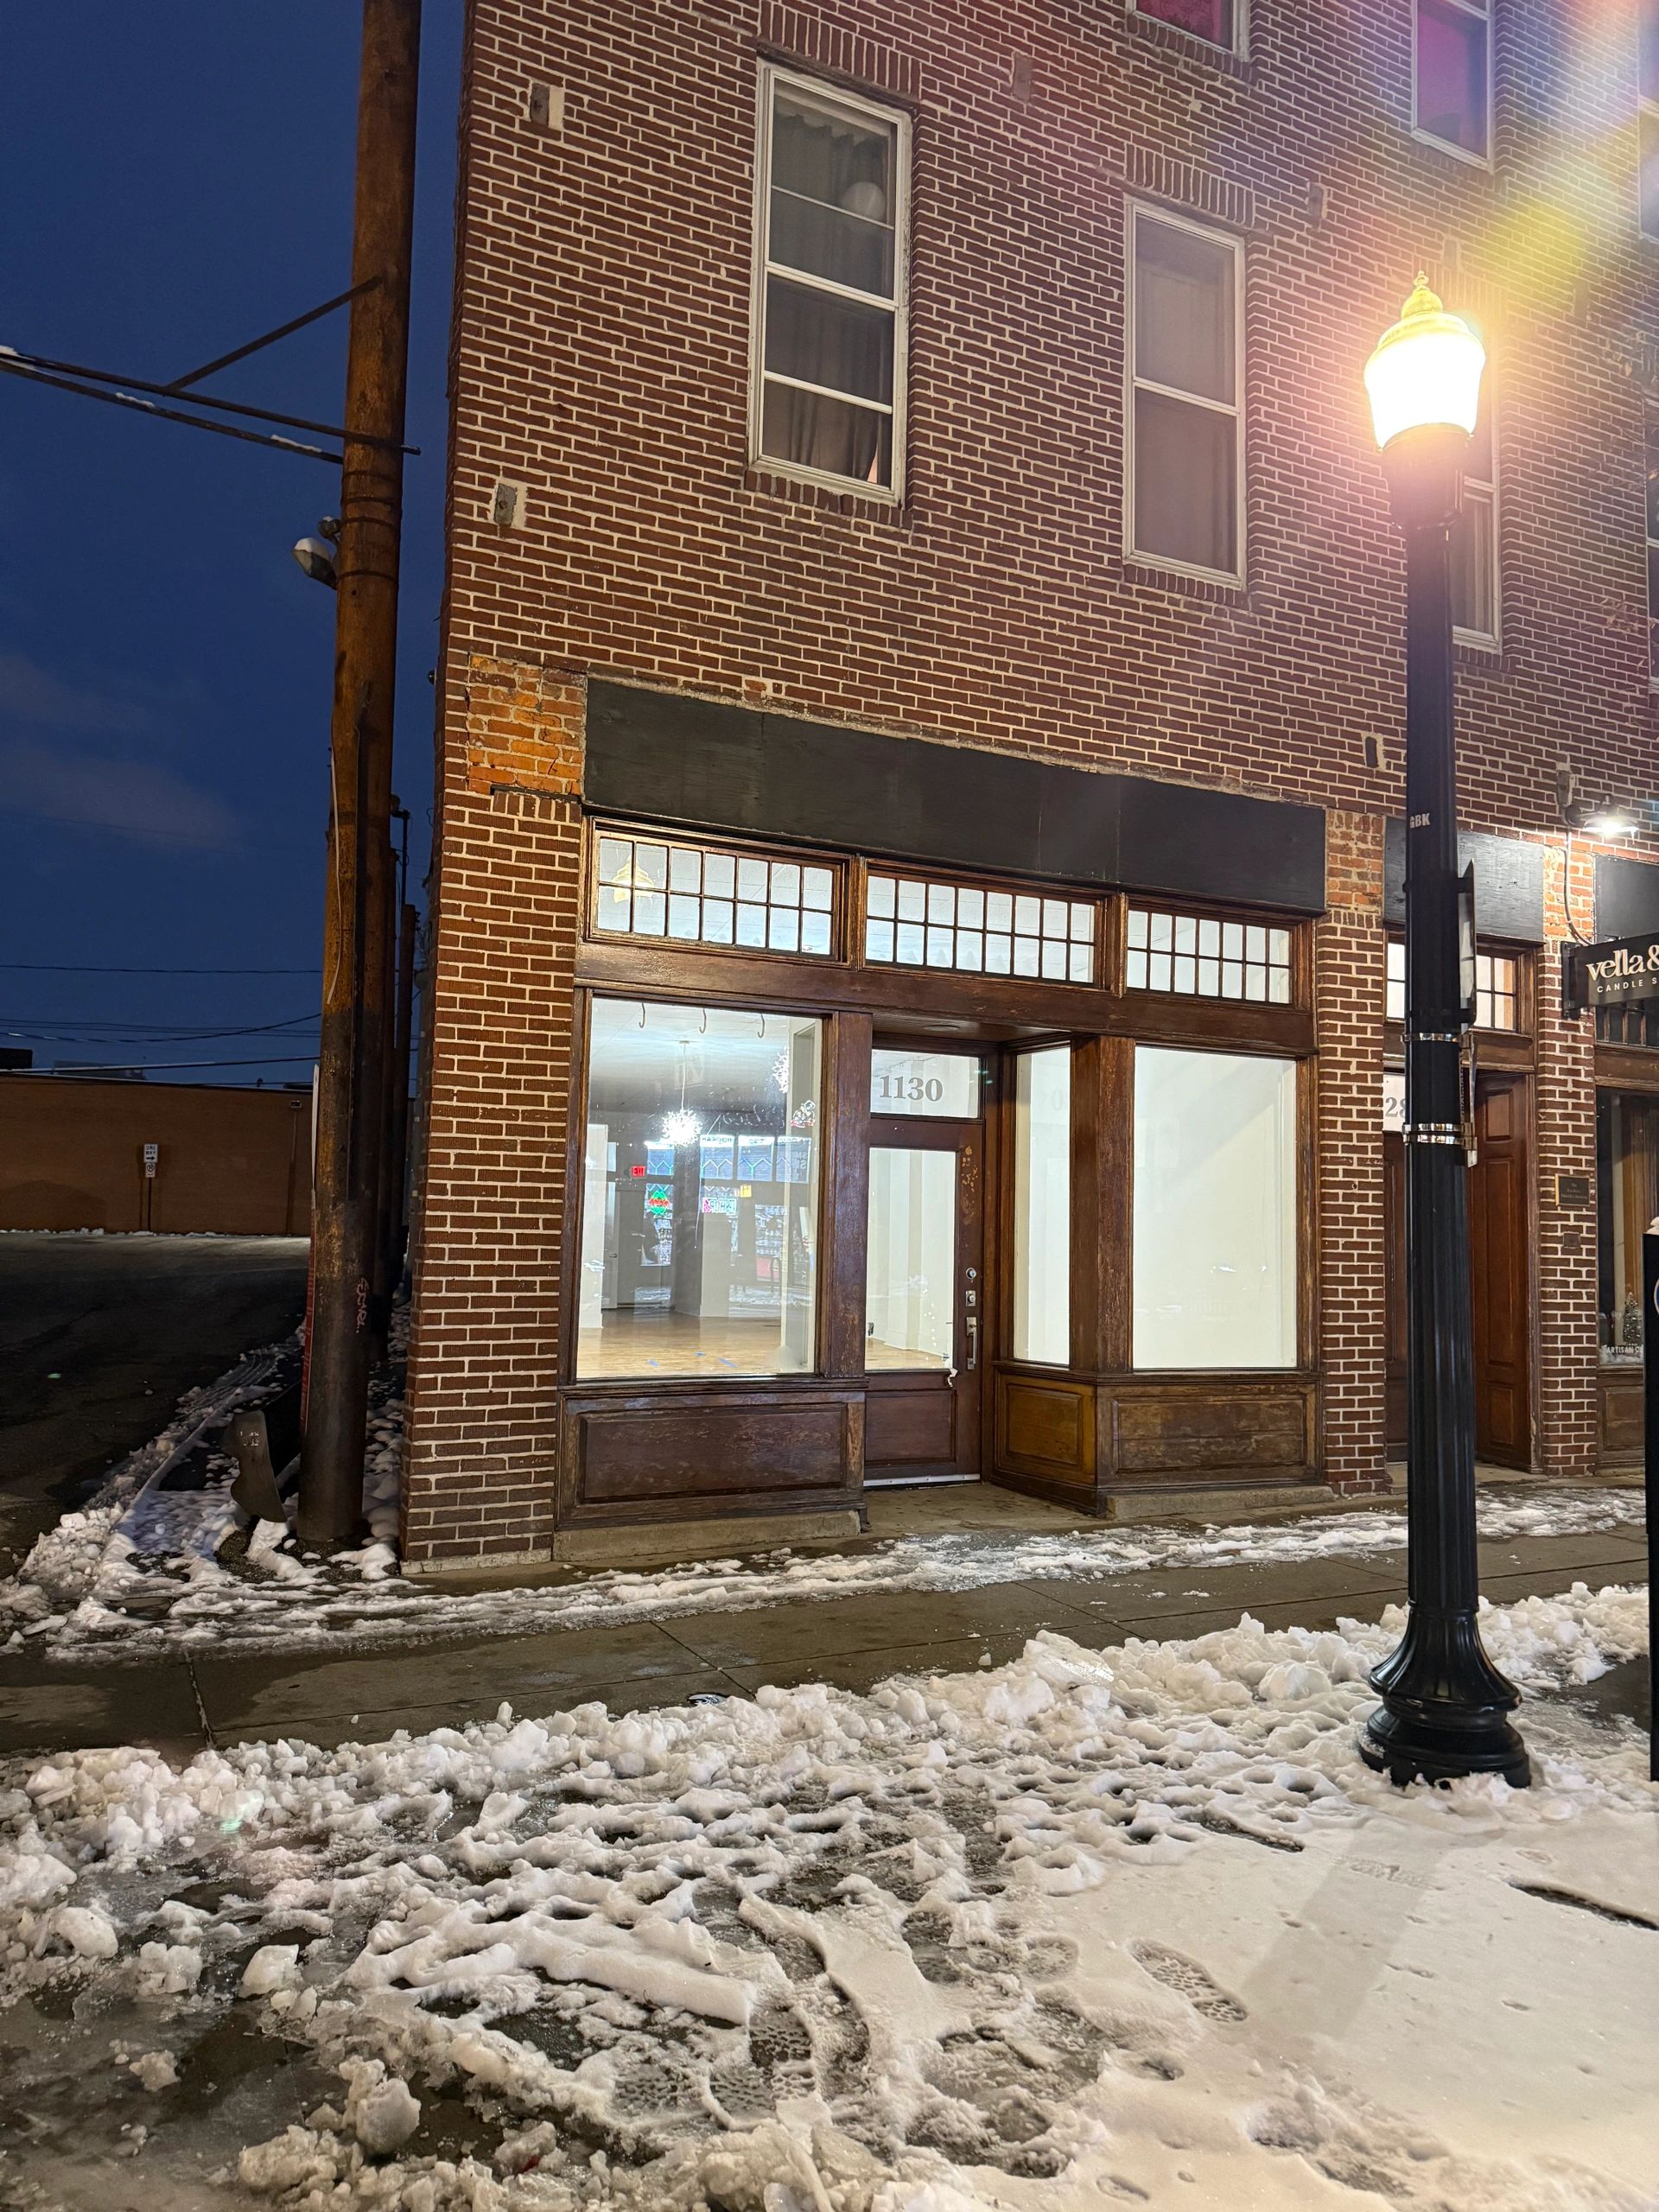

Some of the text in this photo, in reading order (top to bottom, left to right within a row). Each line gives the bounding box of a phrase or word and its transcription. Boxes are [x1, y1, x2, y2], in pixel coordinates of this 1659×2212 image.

[1585, 948, 1646, 982] vella
[1597, 979, 1643, 993] CANDLE
[880, 1075, 944, 1102] 1130
